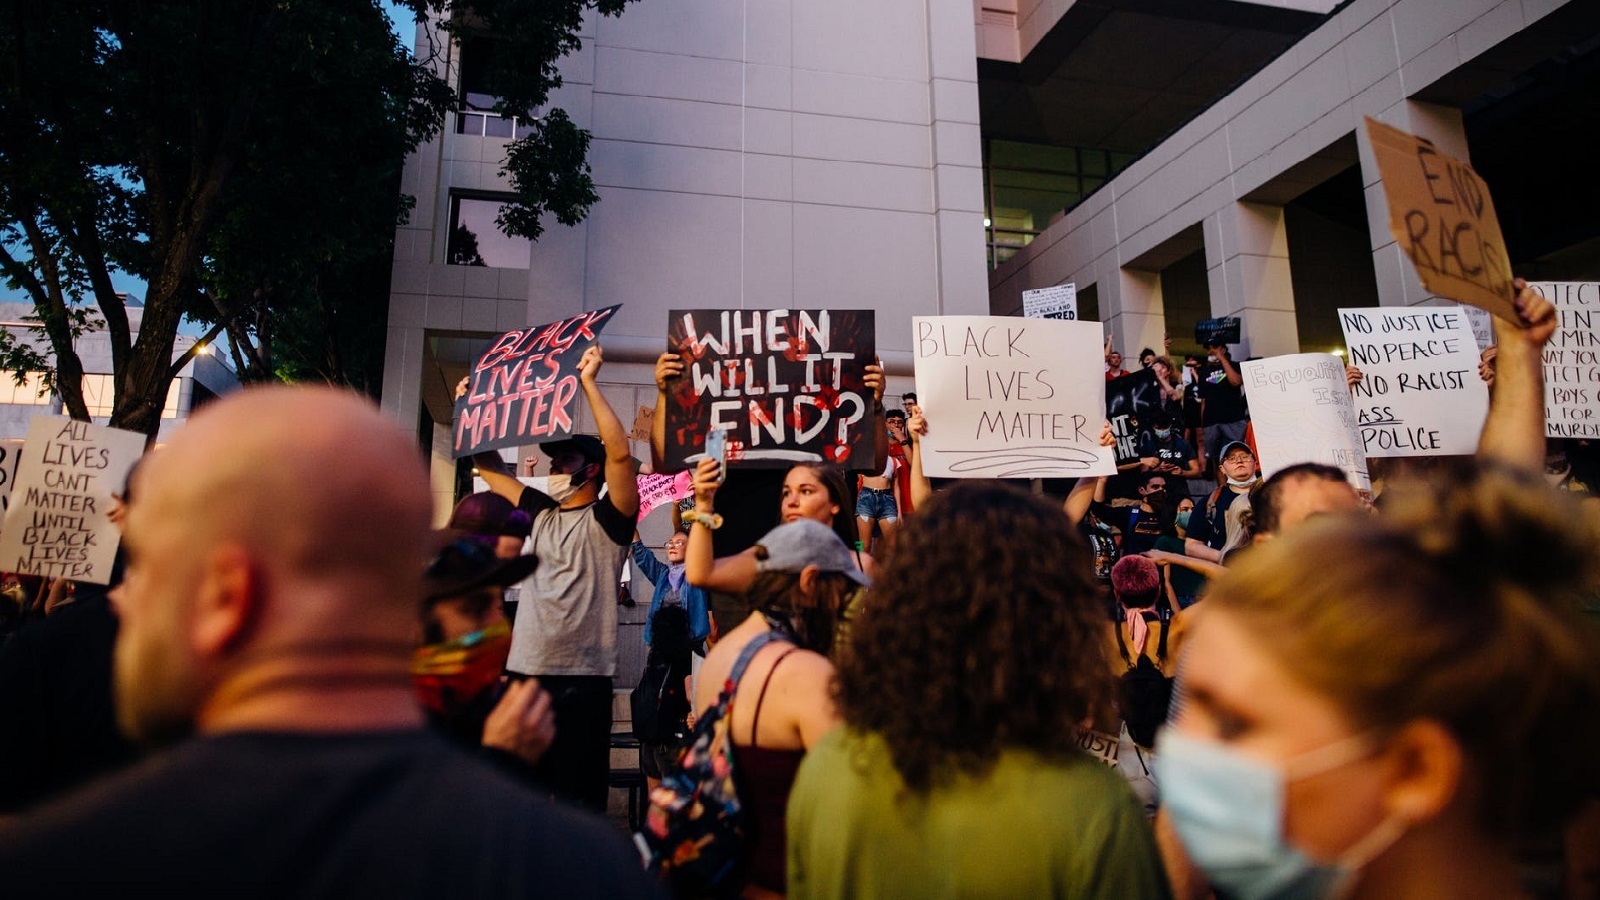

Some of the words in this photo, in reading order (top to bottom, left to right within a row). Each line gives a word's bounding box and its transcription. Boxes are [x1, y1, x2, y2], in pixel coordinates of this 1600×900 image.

[1415, 135, 1485, 220] END
[1058, 304, 1071, 312] AND
[683, 309, 830, 356] WHEN
[1343, 313, 1373, 334] NO
[1381, 313, 1460, 334] JUSTICE
[475, 309, 612, 373] BLACK
[918, 321, 1030, 358] BLACK
[1351, 343, 1381, 366] NO
[1386, 338, 1460, 362] PEACE
[468, 348, 564, 406] LIVES
[692, 355, 789, 397] WILL
[796, 352, 855, 393] IT
[965, 365, 1055, 401] LIVES
[1354, 373, 1389, 398] NO
[1399, 369, 1470, 394] RACIST
[1553, 387, 1588, 405] BOYS
[456, 375, 578, 450] MATTER
[709, 391, 866, 459] END?
[1358, 406, 1397, 424] ASS
[1562, 408, 1596, 420] FOR
[56, 421, 94, 441] ALL
[976, 410, 1094, 443] MATTER
[1361, 426, 1441, 453] POLICE
[42, 440, 110, 469] LIVES
[44, 469, 97, 491] CANT
[24, 487, 96, 514] MATTER
[33, 511, 91, 532] UNTIL
[22, 527, 97, 547] BLACK
[29, 545, 88, 561] LIVES
[16, 556, 93, 578] MATTER
